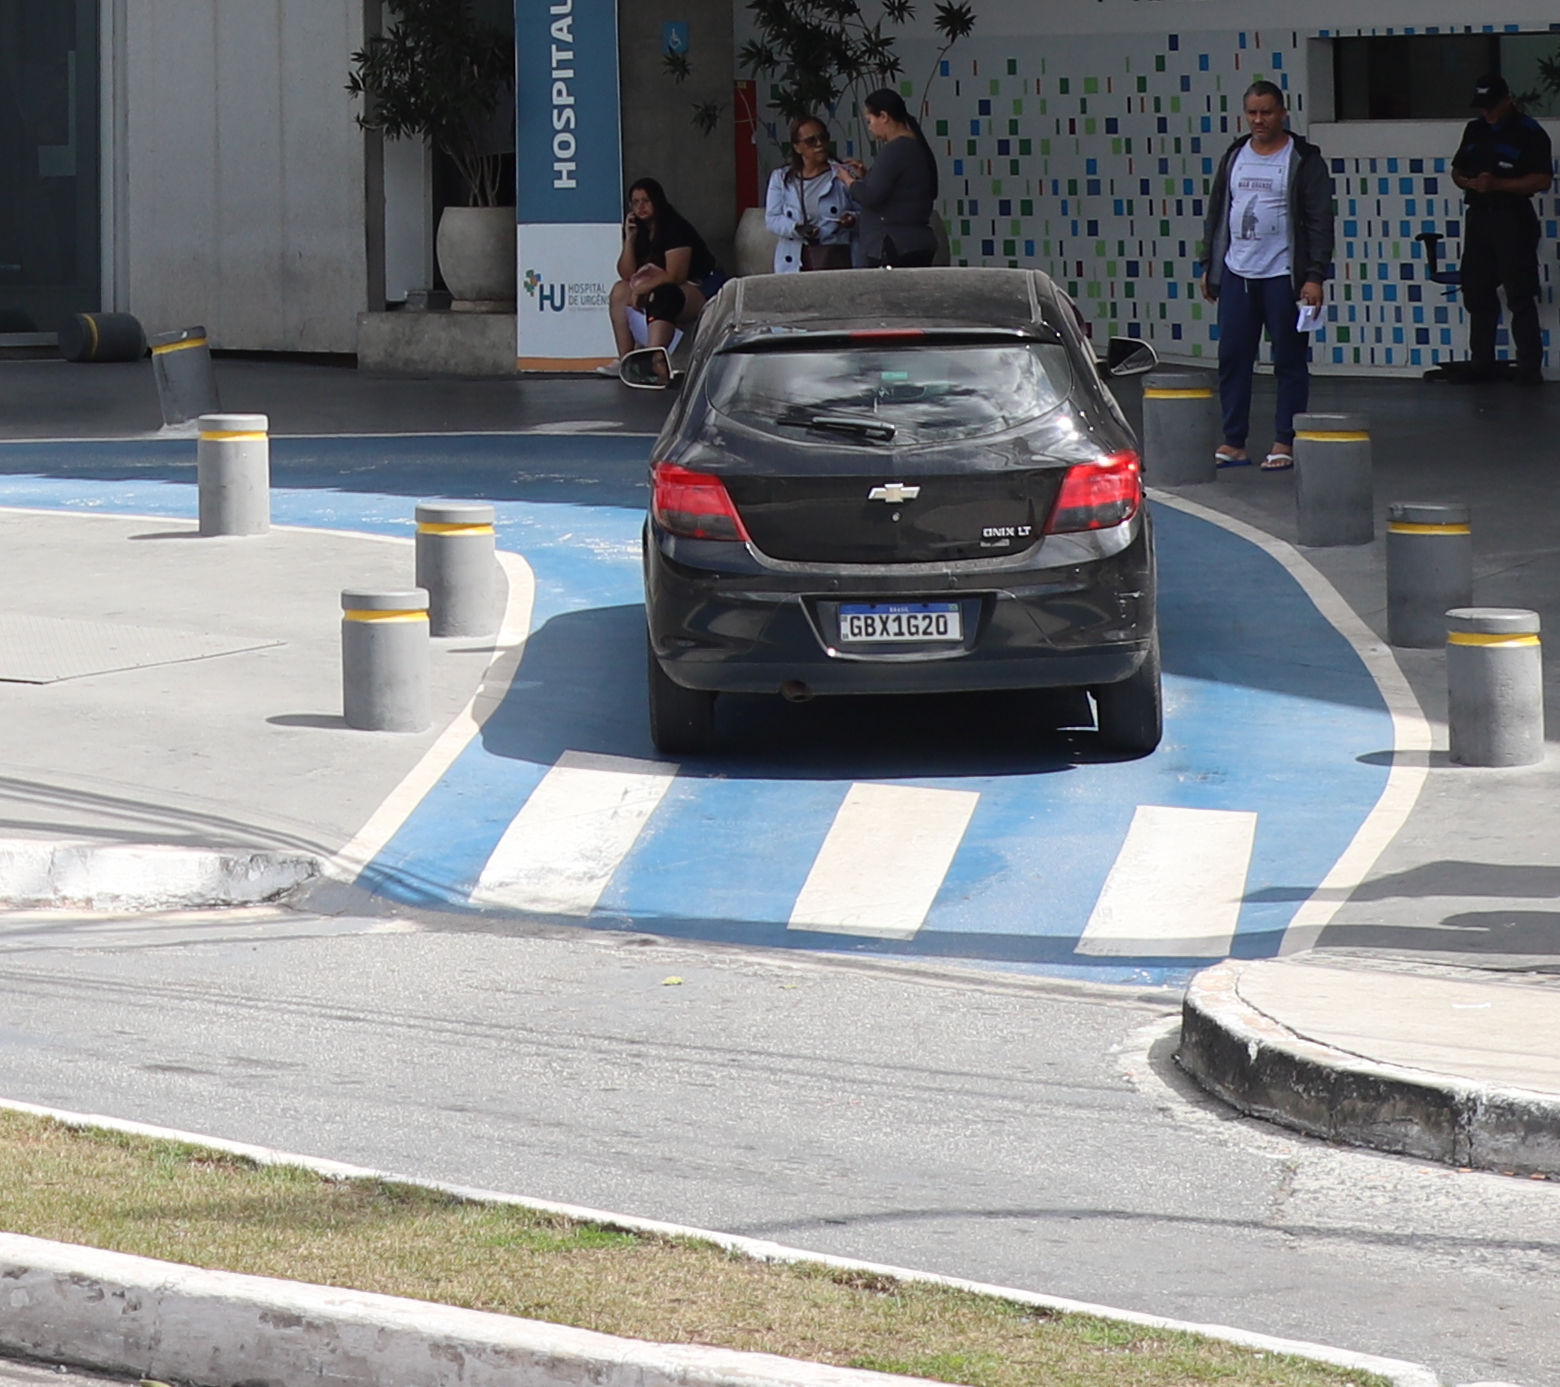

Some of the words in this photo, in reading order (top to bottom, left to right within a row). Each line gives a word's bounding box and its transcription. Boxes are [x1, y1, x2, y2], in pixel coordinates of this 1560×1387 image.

[568, 283, 606, 294] HOSPITAL
[539, 283, 566, 312] HU
[568, 295, 578, 305] DE
[580, 293, 609, 306] URGÊN
[982, 527, 1015, 537] ONIX
[1017, 525, 1032, 536] LT
[849, 614, 948, 638] GBX1G20
